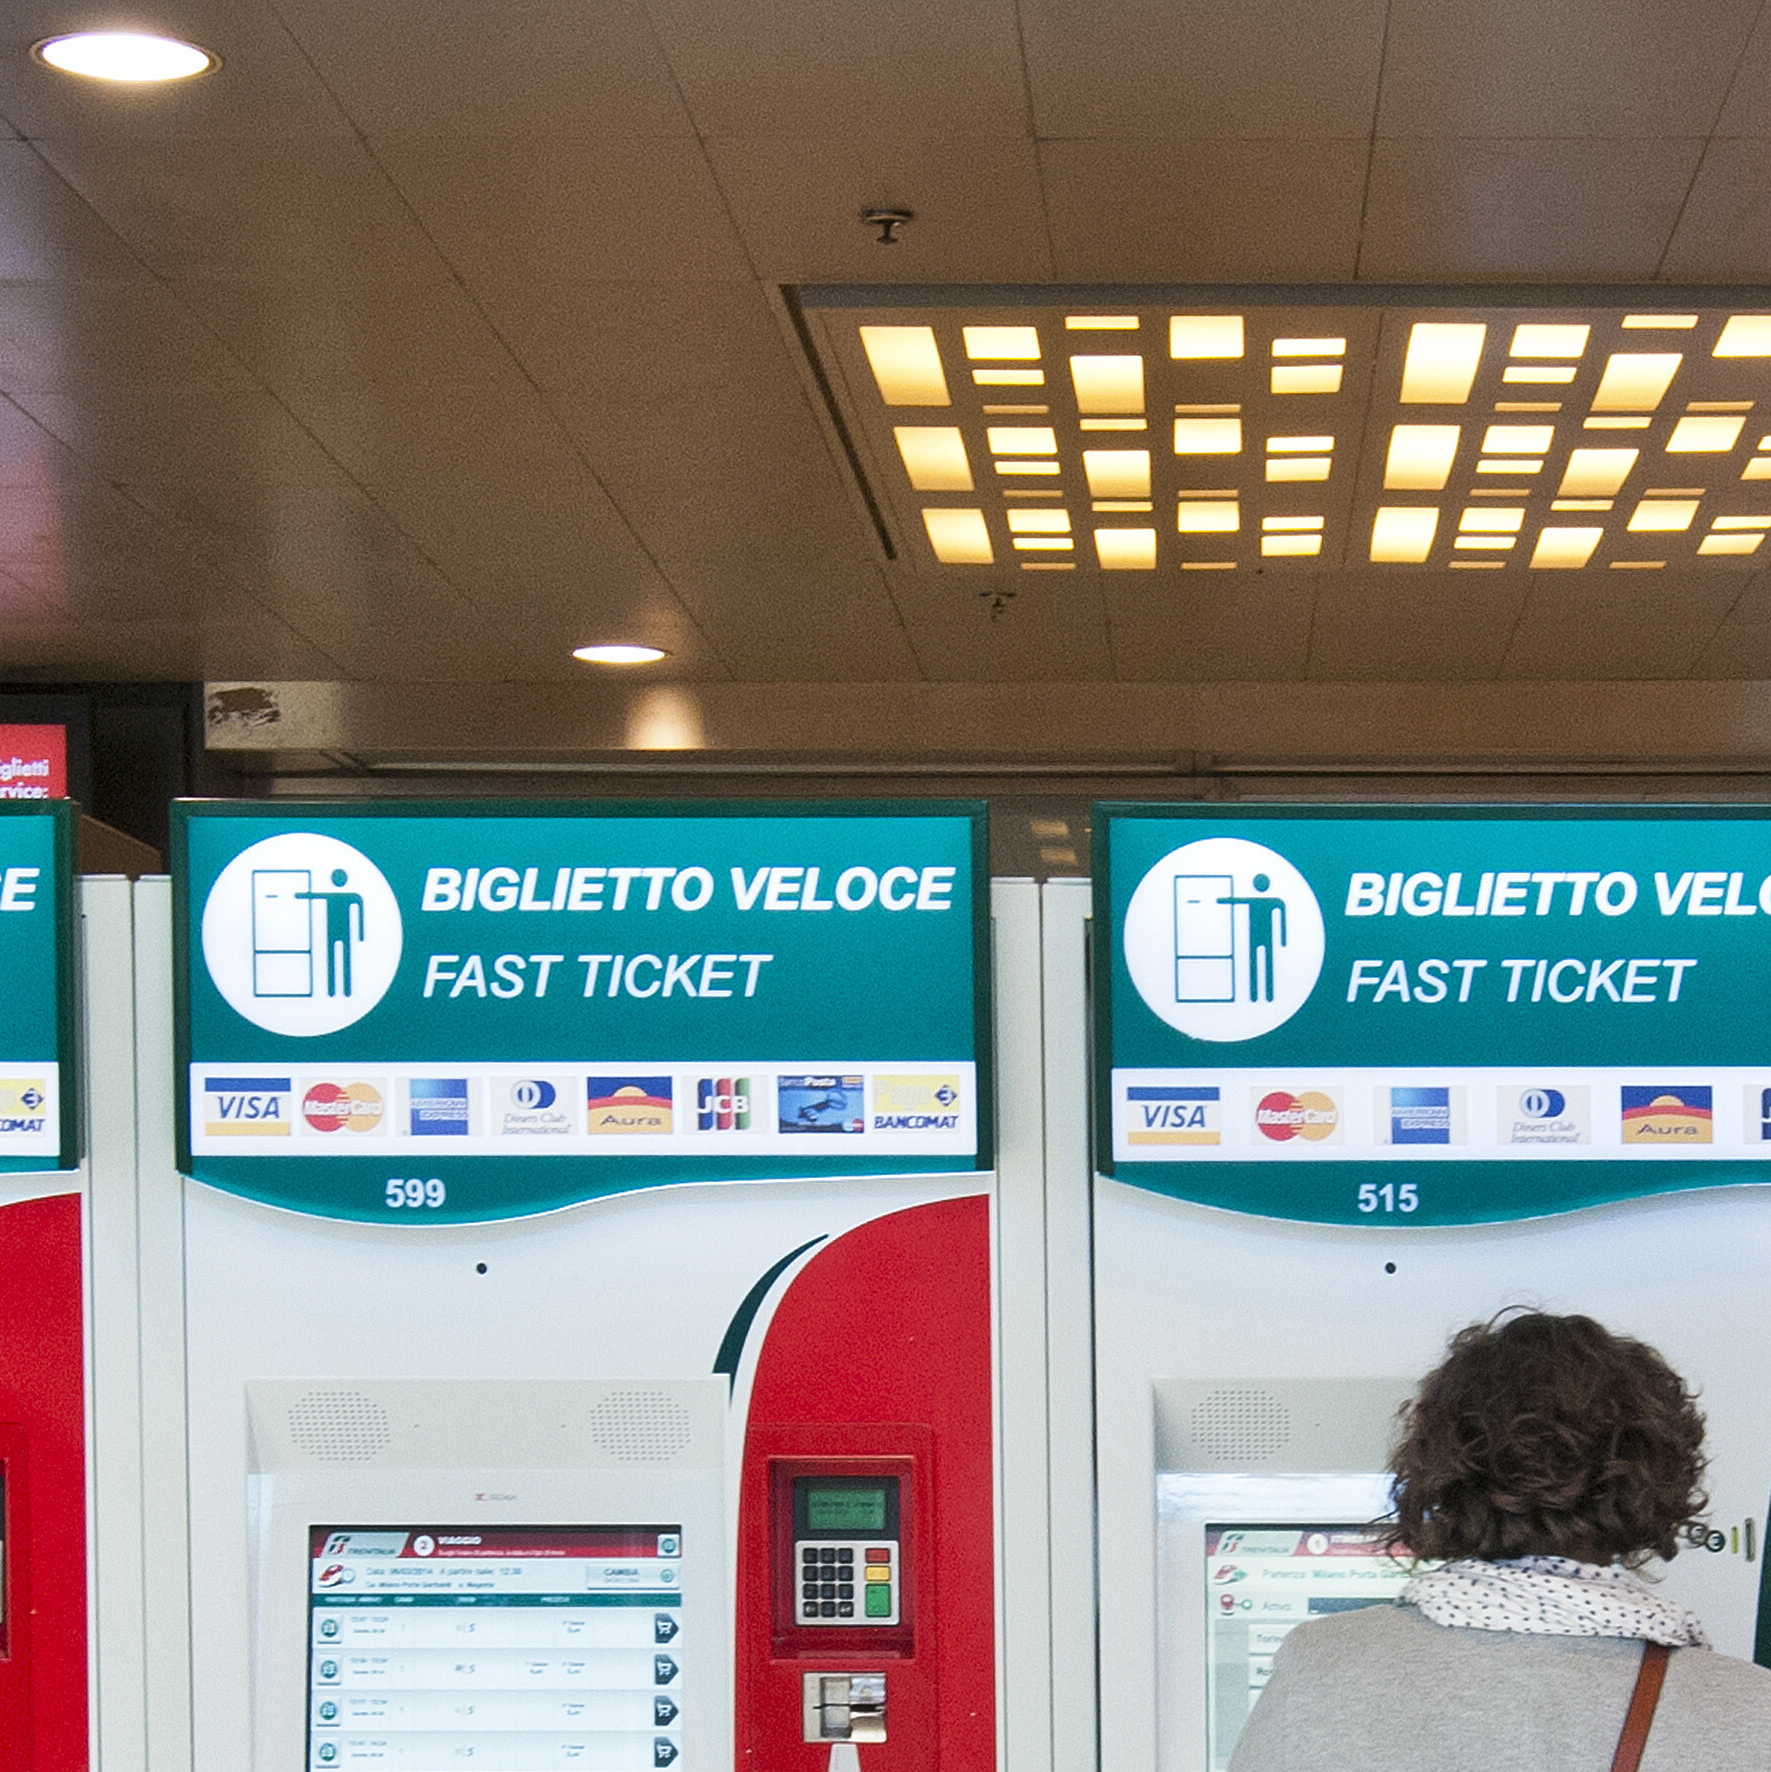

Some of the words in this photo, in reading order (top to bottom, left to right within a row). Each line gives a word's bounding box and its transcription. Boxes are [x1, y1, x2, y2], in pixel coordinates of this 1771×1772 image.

[421, 866, 714, 912] BIGLIETTO
[730, 866, 956, 911] VELOCE
[1345, 871, 1637, 917] BIGLIETTO
[423, 954, 564, 998] FAST
[577, 954, 773, 998] TICKET
[1347, 959, 1488, 1003] FAST
[1501, 959, 1697, 1003] TICKET
[217, 1096, 282, 1119] VISA
[304, 1100, 381, 1116] MasterCard
[697, 1096, 750, 1114] JCB
[600, 1115, 662, 1126] Aura
[874, 1115, 959, 1129] BANCOMAT
[1142, 1105, 1208, 1128] VISA
[1257, 1108, 1336, 1125] MasterCard
[1512, 1121, 1545, 1132] Diners
[1549, 1121, 1575, 1132] Club
[1638, 1124, 1699, 1135] Aura
[385, 1179, 446, 1208] 599
[1358, 1183, 1419, 1212] 515
[420, 1540, 427, 1550] 2
